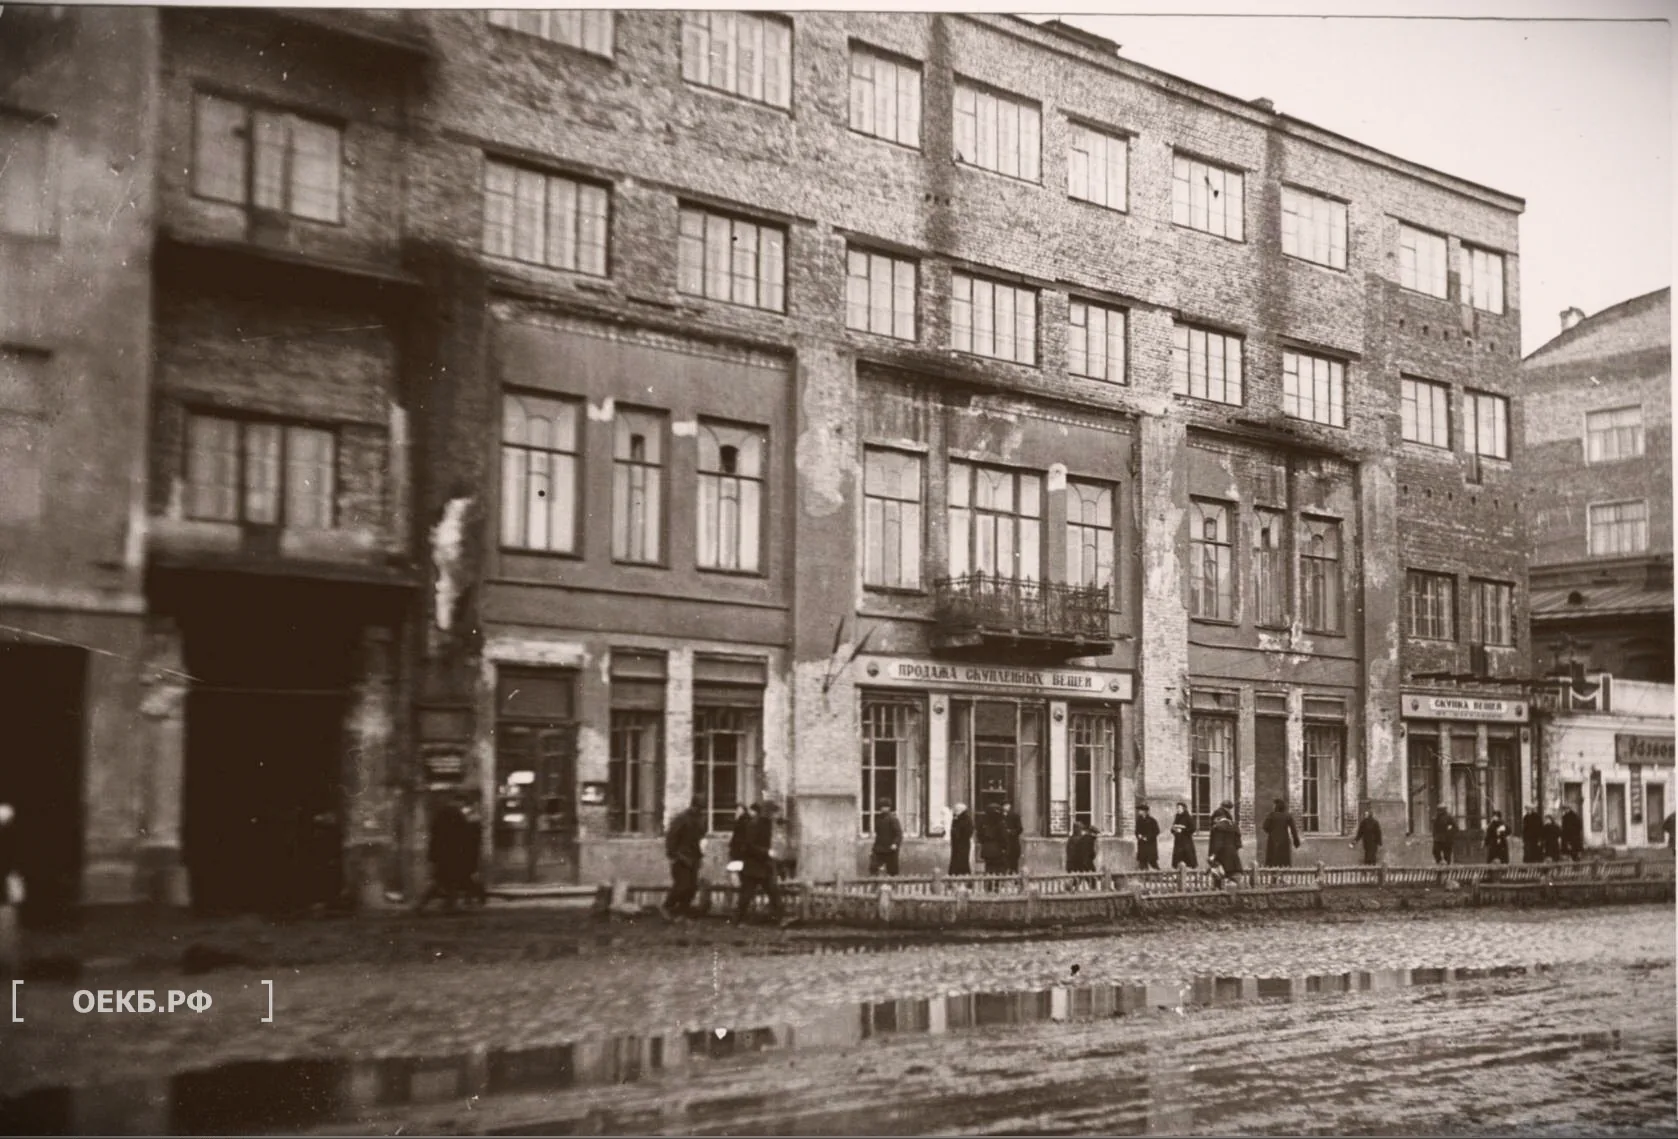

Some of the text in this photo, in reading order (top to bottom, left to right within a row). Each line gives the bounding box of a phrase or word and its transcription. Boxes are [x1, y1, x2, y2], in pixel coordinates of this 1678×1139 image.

[898, 663, 958, 680] ПРОДАЖА
[965, 668, 1044, 686] СКУПЛЕННЫХ
[1434, 699, 1469, 709] СКУПКА
